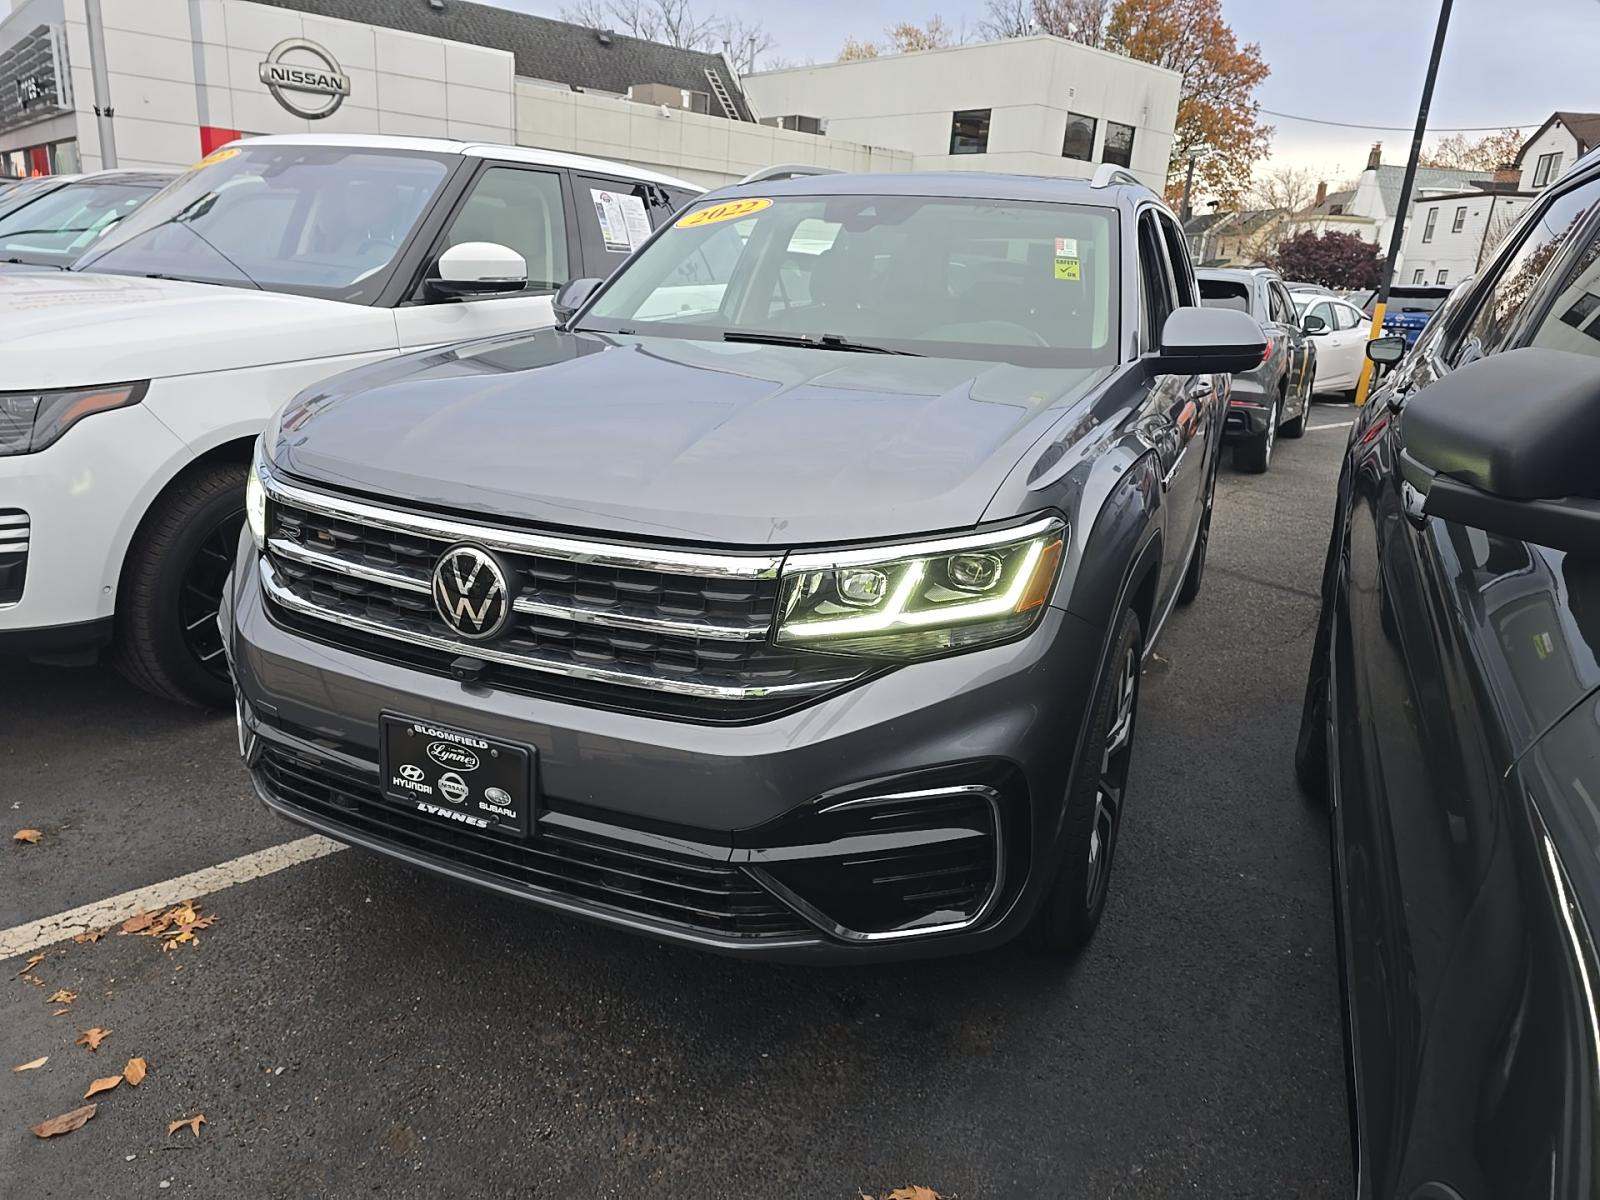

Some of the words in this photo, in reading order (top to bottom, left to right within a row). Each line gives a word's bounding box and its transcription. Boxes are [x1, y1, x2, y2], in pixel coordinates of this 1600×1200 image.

[271, 67, 343, 90] NISSAN
[689, 201, 759, 225] 2022
[413, 724, 489, 749] BLOOMFIELD
[430, 743, 477, 765] Lynnes
[392, 776, 433, 795] HYUNDAI
[441, 781, 466, 793] NISSAN
[416, 802, 489, 828] LYNNES
[478, 801, 518, 819] SUBARU
